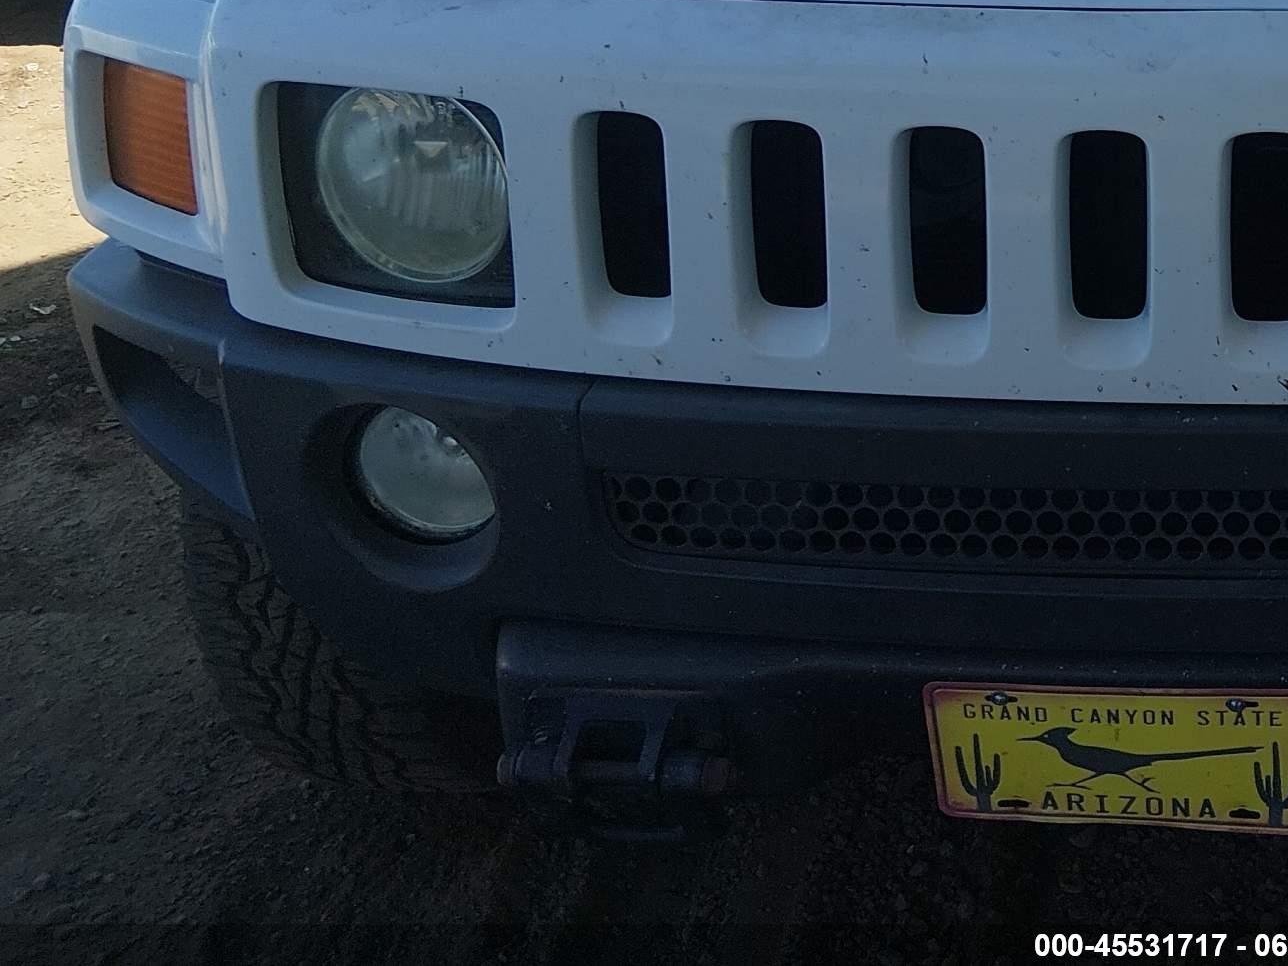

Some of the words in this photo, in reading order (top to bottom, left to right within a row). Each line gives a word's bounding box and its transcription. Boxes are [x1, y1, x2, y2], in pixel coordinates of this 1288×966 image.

[963, 702, 1049, 723] GRAND
[1070, 708, 1176, 726] CANYON
[1196, 709, 1283, 728] STATE
[1040, 790, 1217, 819] ARIZONA
